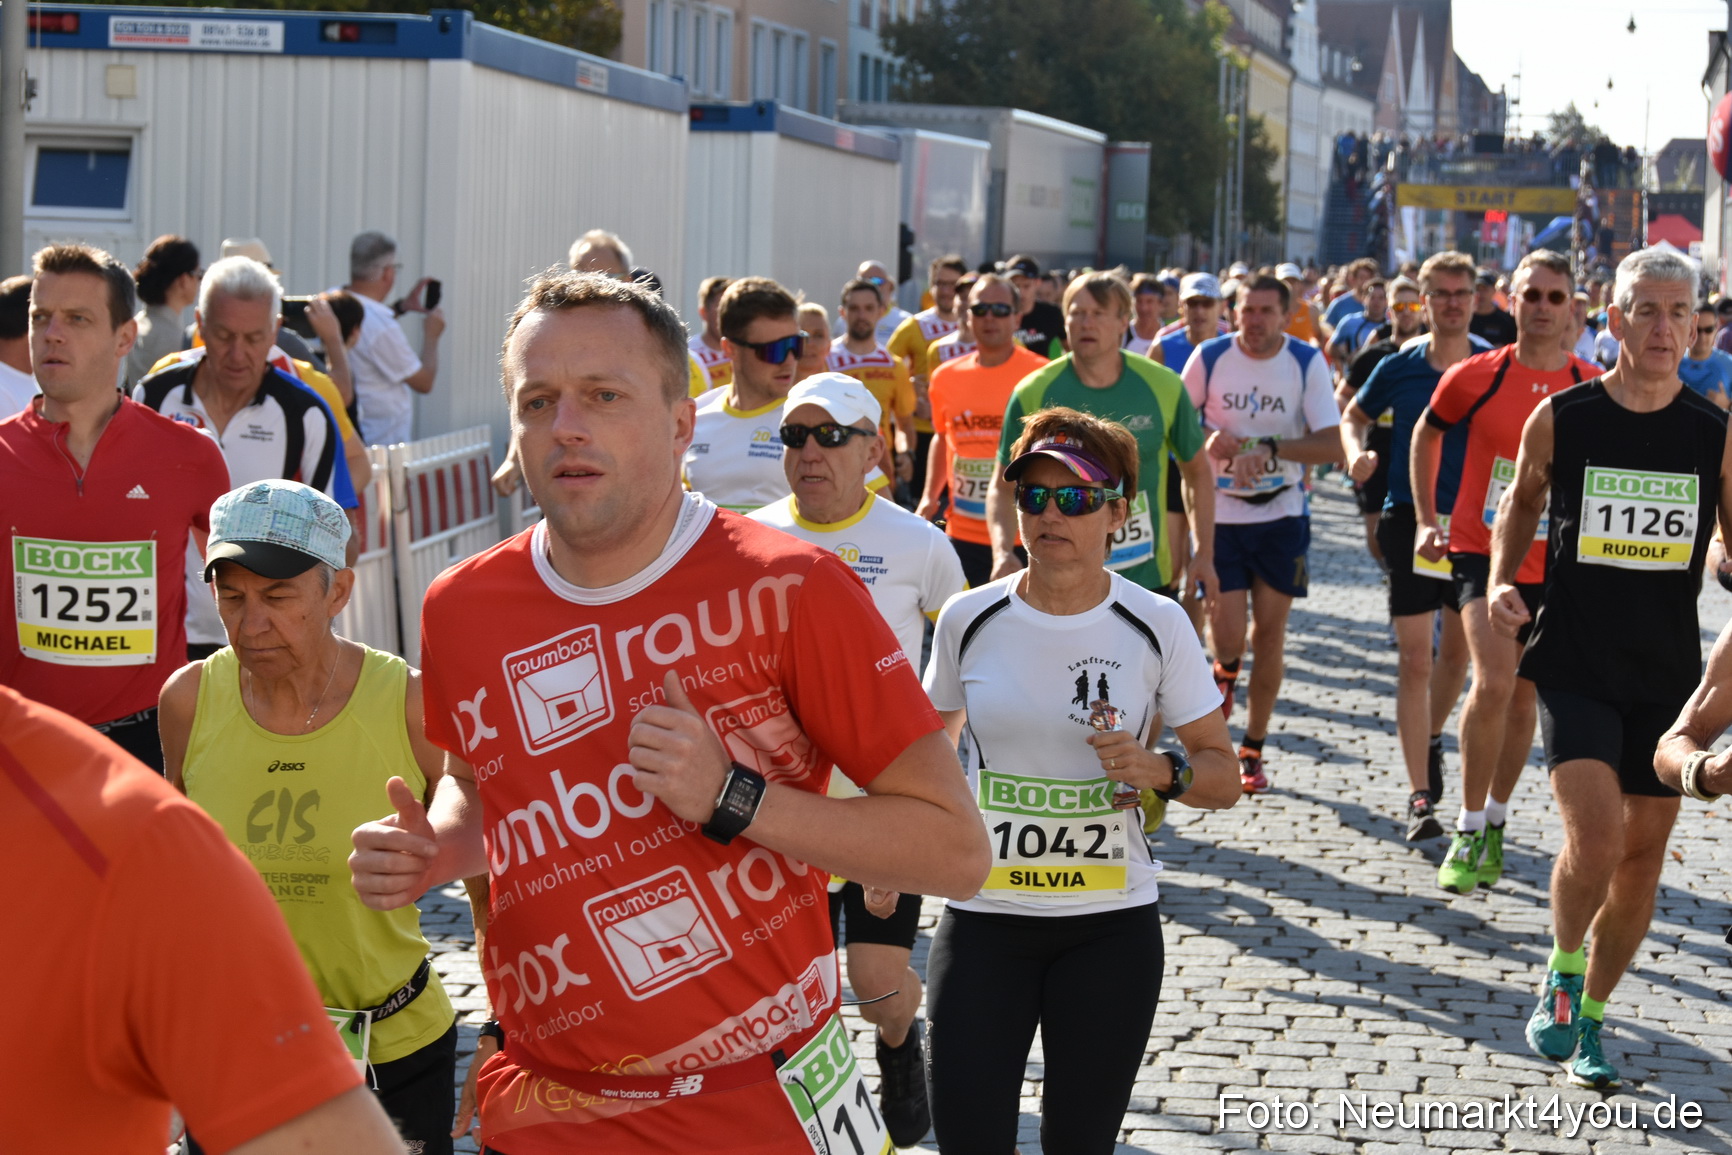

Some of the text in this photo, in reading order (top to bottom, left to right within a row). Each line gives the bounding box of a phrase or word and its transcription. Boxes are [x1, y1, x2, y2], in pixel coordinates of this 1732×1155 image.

[1456, 190, 1516, 207] START
[753, 431, 771, 442] 20
[1593, 472, 1690, 501] BOCK
[1597, 504, 1685, 538] 1126
[24, 543, 144, 574] BOCK
[837, 547, 859, 562] 20
[1602, 543, 1671, 558] RUDOLF
[850, 565, 889, 575] markter
[32, 583, 138, 622] 1252
[37, 631, 131, 650] MICHAEL
[510, 634, 594, 680] raumbox
[1067, 656, 1122, 672] Lauftreff
[628, 662, 744, 714] schnken
[280, 762, 306, 771] asics
[989, 776, 1114, 813] BOCK
[993, 821, 1109, 860] 1042
[525, 854, 612, 897] wohnen
[1009, 870, 1086, 887] SILVIA
[593, 878, 687, 926] raumbox
[536, 1001, 605, 1040] outdoor
[600, 1088, 660, 1099] new balance
